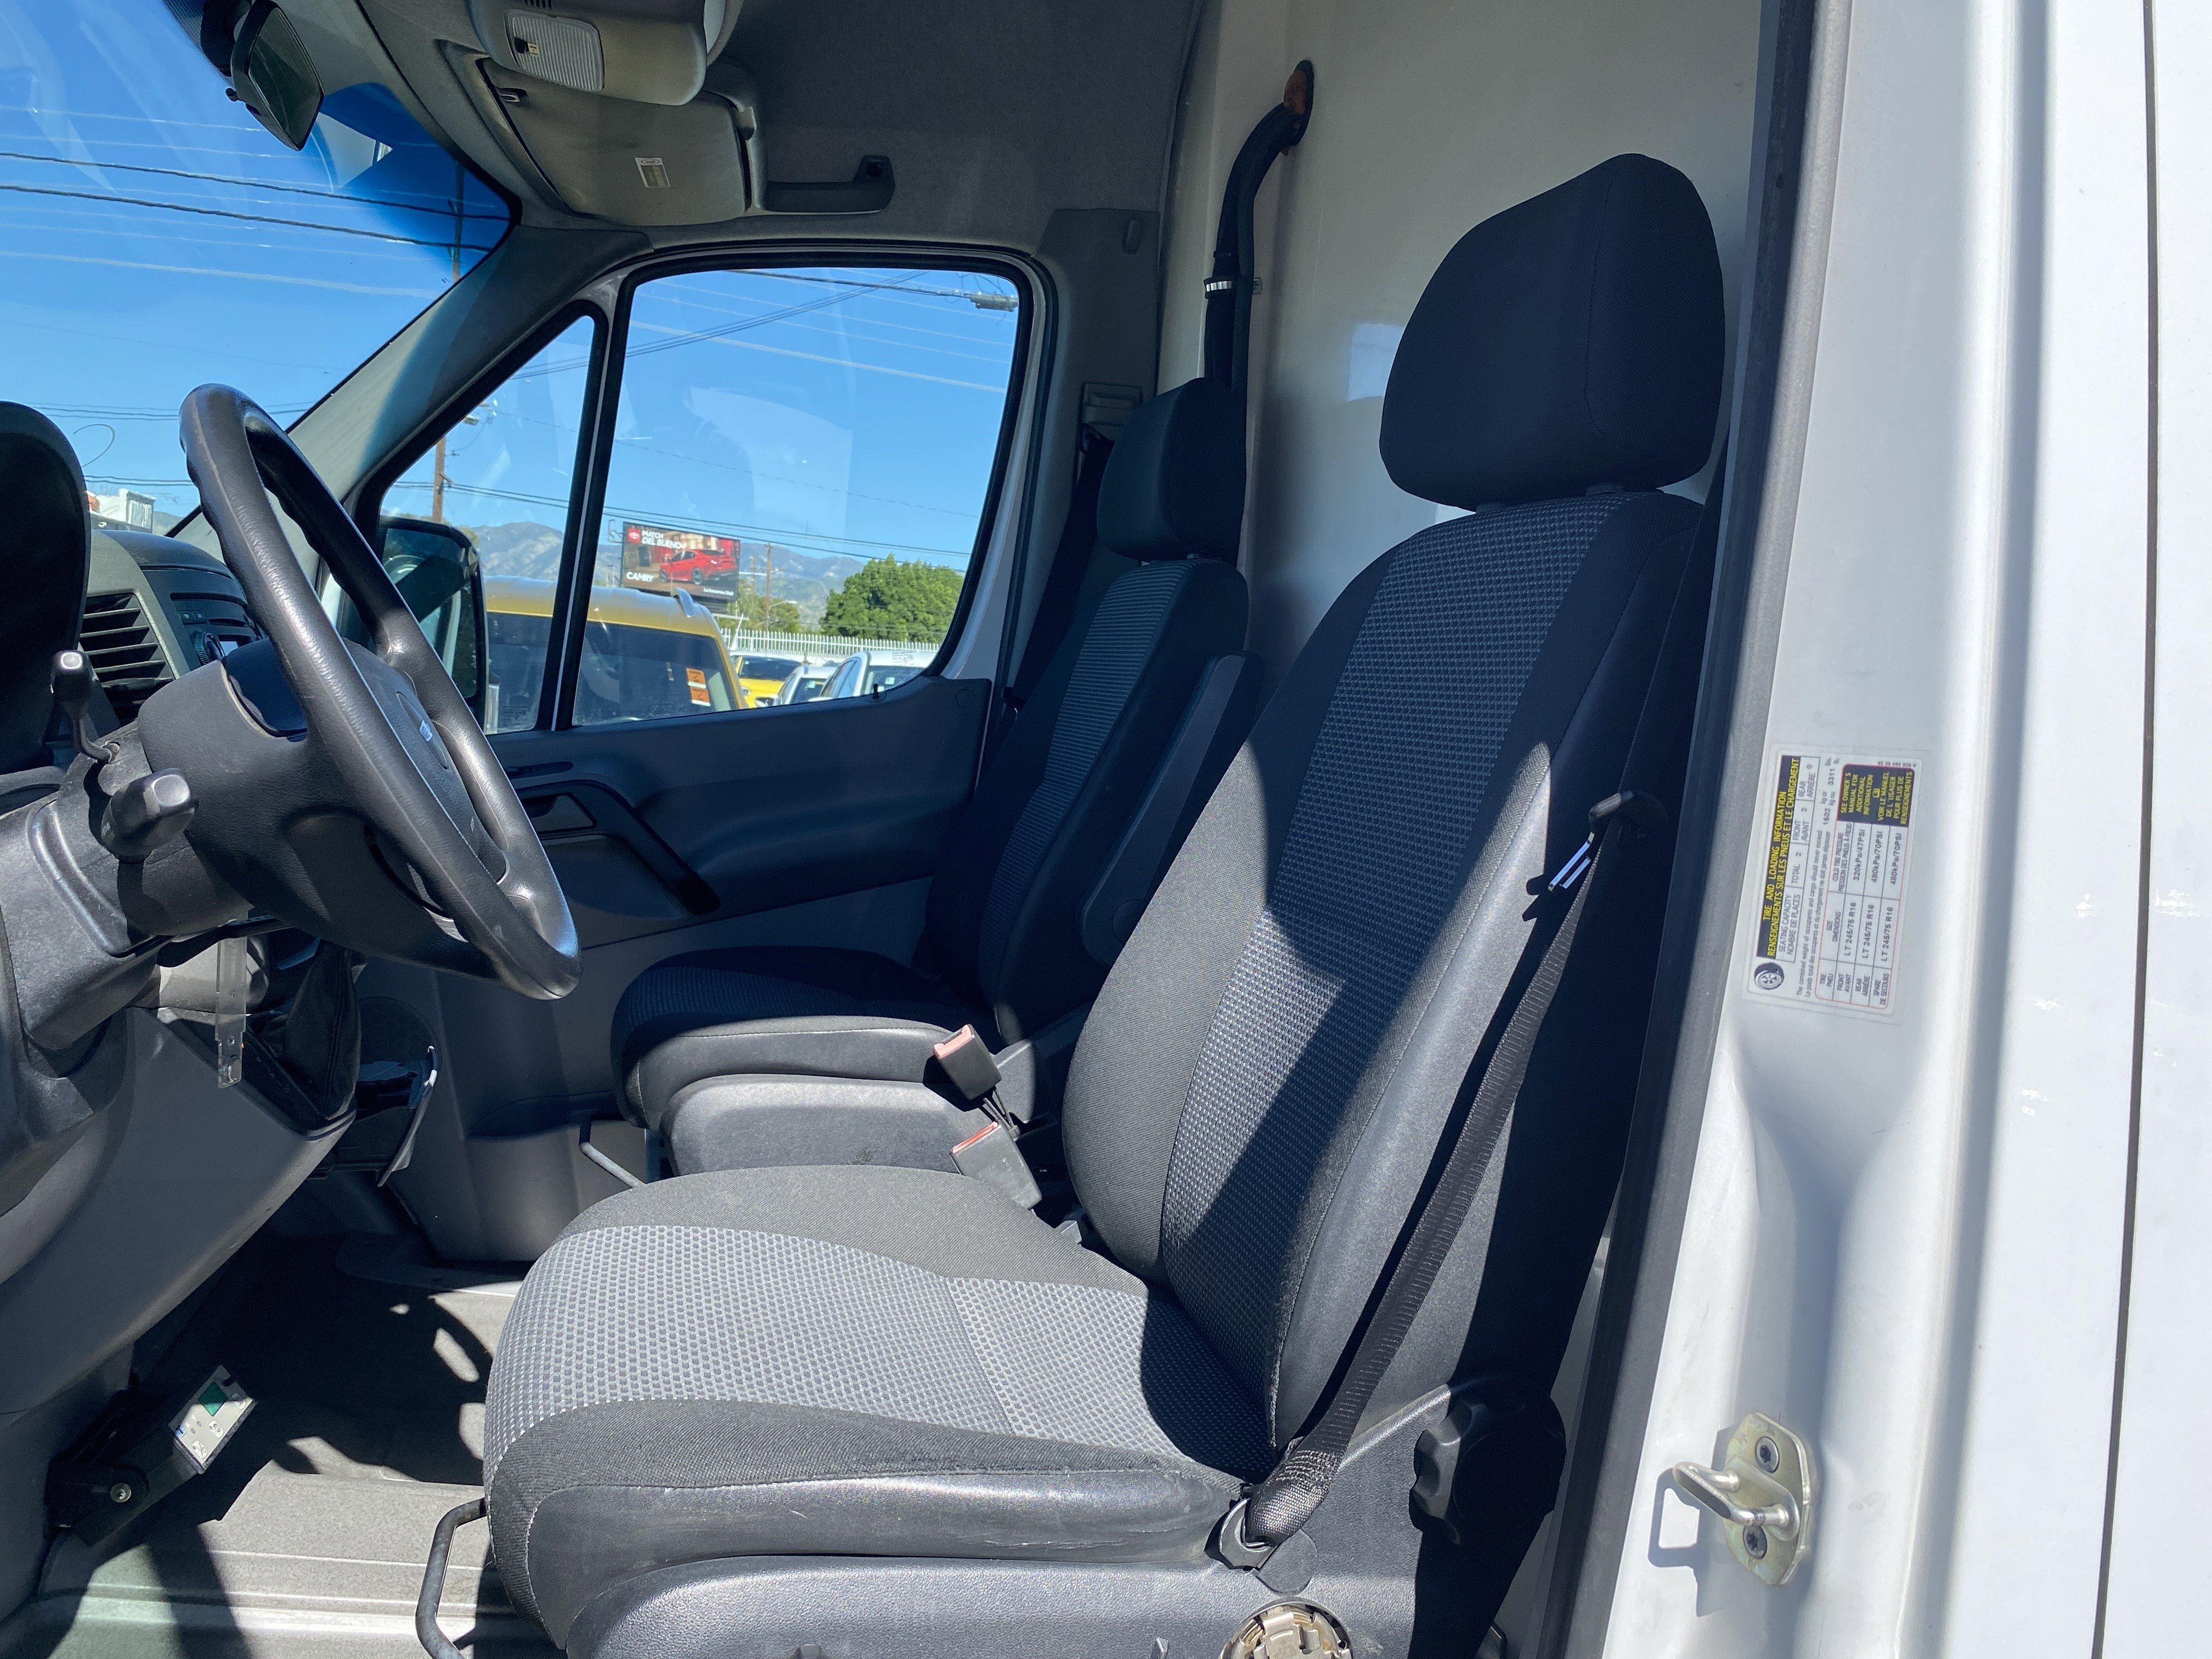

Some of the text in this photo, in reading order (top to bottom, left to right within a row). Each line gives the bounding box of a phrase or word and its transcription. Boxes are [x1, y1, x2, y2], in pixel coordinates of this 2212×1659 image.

[642, 530, 664, 539] MATCH
[642, 537, 682, 549] DEL BUENO
[626, 571, 654, 582] CAMRY
[1797, 780, 1806, 797] REAR
[1804, 772, 1815, 798] ARRIÈRE
[1880, 770, 1889, 795] MANUEL
[1897, 776, 1904, 784] DE
[1848, 787, 1857, 813] MANUAL
[1855, 775, 1865, 812] ADDITIONAL
[1863, 774, 1874, 815] INFORMATION
[1900, 771, 1912, 825] RENSEIGNEMENTS
[1886, 808, 1892, 817] DE
[1792, 819, 1801, 840] FRONT
[1800, 820, 1809, 842] AVANT
[1822, 831, 1831, 853] dépasser
[1835, 832, 1843, 856] PRESSURE
[1762, 791, 1787, 921] TIRE AND LOADING INFORMATION
[1767, 758, 1799, 956] RENSEIGNEMENTS SUR LES PNEUS ET LE CHARGEMENT
[1820, 853, 1829, 868] jamais
[1853, 829, 1865, 881] 320kPa/47PSI
[1870, 831, 1883, 883] 480kPa/70PSI
[1889, 832, 1901, 885] 480kPa/70PSI
[1791, 864, 1800, 884] TOTAL
[1838, 869, 1846, 892] PRESSION
[1814, 887, 1825, 916] chargement
[1778, 894, 1792, 952] SEATING CAPACITY
[1786, 894, 1801, 955] NOMBRE DE PLACES
[1804, 909, 1814, 934] occupants
[1832, 911, 1841, 942] DIMENSIONS
[1845, 918, 1854, 944] 245/75
[1863, 921, 1872, 946] 245/75
[1810, 929, 1819, 954] occupants
[1882, 923, 1891, 949] 245/75
[1801, 943, 1809, 960] weight
[1844, 945, 1851, 956] LT
[1862, 948, 1869, 958] LT
[1881, 951, 1888, 961] LT
[1798, 961, 1806, 984] combined
[1880, 973, 1889, 996] SECOURS
[1860, 975, 1870, 996] ARRIÈRE
